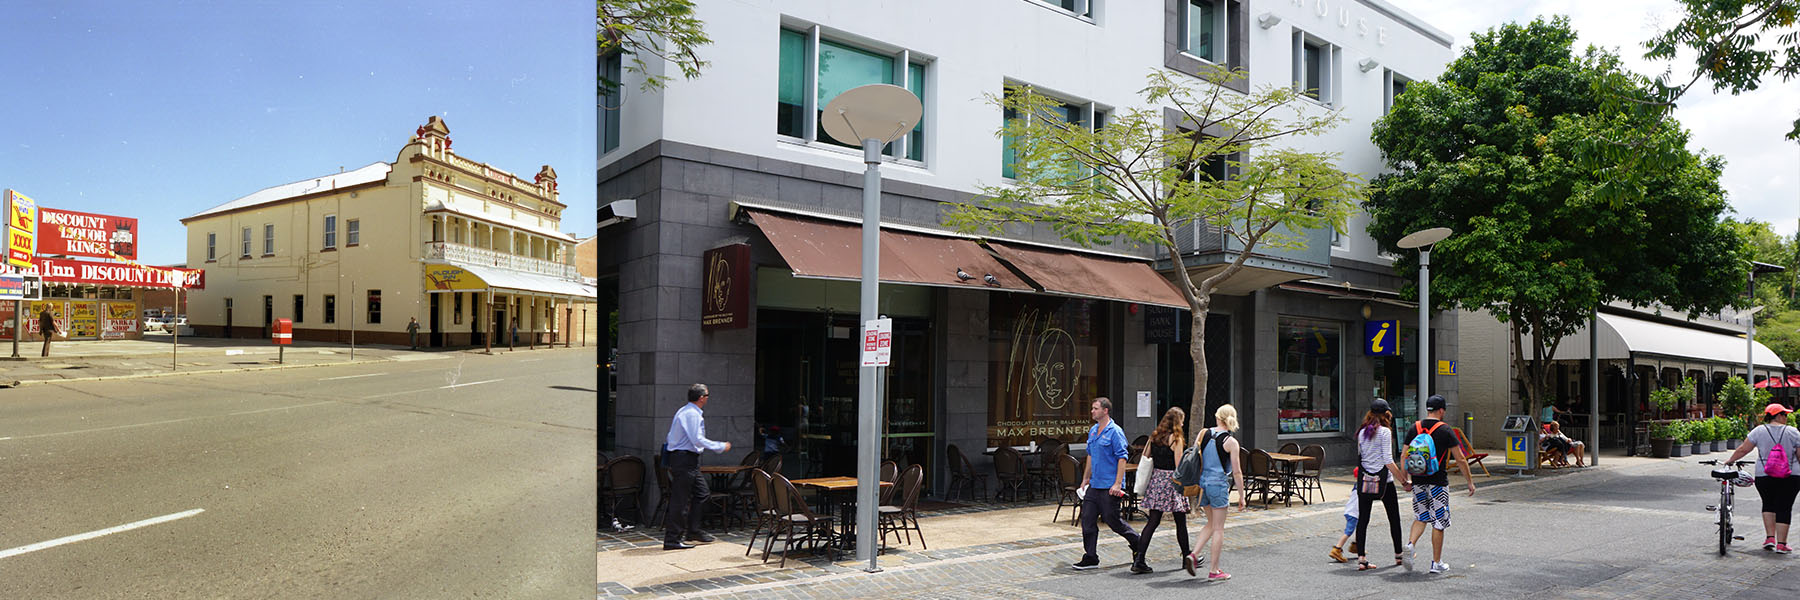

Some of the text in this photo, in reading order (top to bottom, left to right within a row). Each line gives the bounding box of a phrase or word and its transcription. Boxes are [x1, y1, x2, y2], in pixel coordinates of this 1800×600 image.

[42, 211, 107, 229] DISCOUNT
[13, 233, 32, 251] XXXX
[60, 226, 107, 242] LIQUOR
[67, 240, 107, 255] KINGS
[42, 260, 76, 278] Inn
[81, 264, 154, 284] DISCOUNT
[997, 425, 1090, 437] MAX BRENNER
